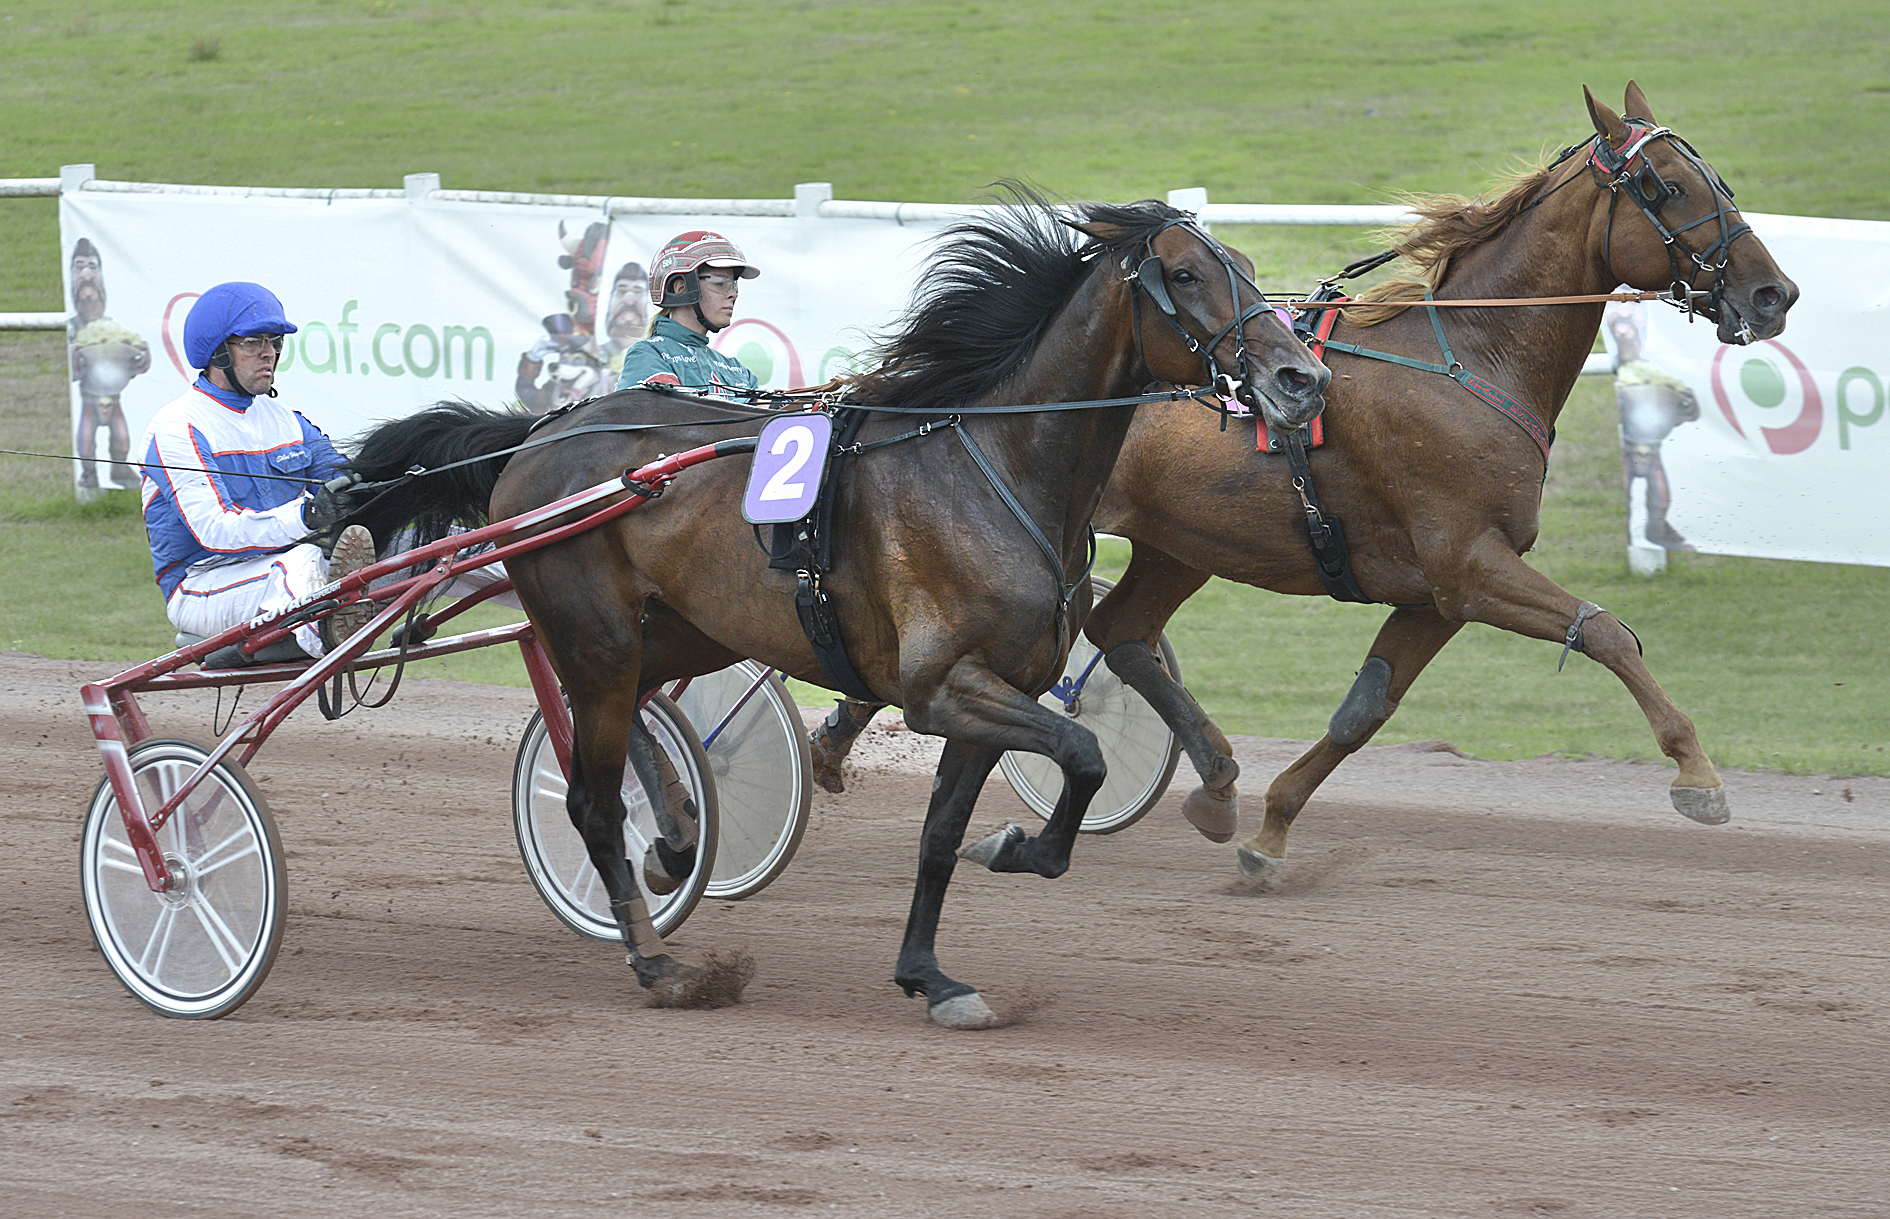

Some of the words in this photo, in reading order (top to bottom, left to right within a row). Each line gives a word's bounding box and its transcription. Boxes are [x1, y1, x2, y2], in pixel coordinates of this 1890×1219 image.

[275, 299, 495, 381] af.com
[1467, 377, 1505, 404] STALL
[759, 425, 814, 501] 2
[250, 594, 313, 630] ROYAL
